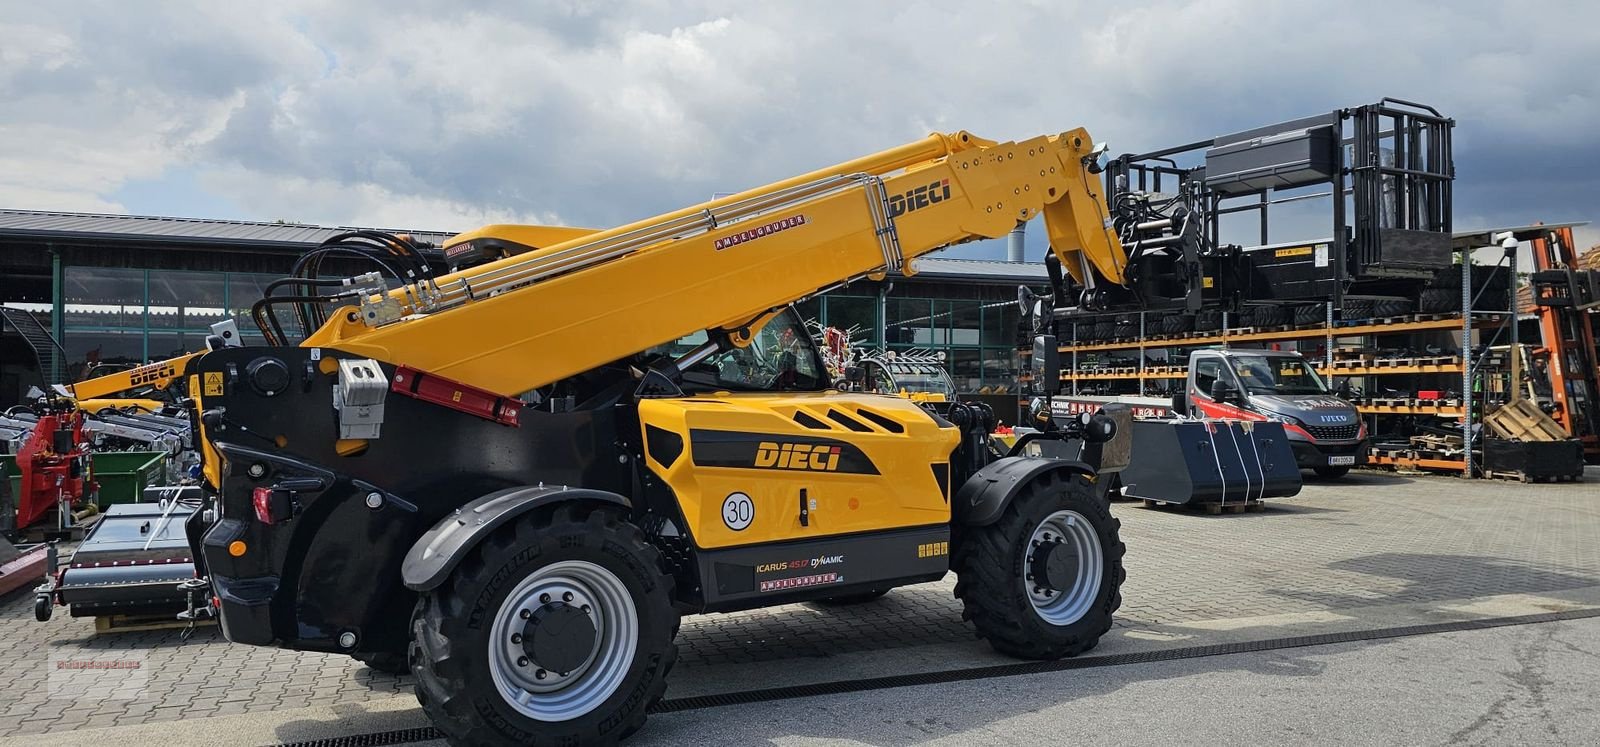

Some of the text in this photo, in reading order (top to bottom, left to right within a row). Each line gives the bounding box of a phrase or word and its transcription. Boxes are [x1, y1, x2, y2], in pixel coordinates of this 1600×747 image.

[715, 214, 805, 250] AMSELGRUBER
[727, 500, 750, 524] 30
[756, 562, 788, 573] ICARUS
[811, 555, 844, 568] DYNAMIC
[761, 573, 837, 592] AMSELGRUBER
